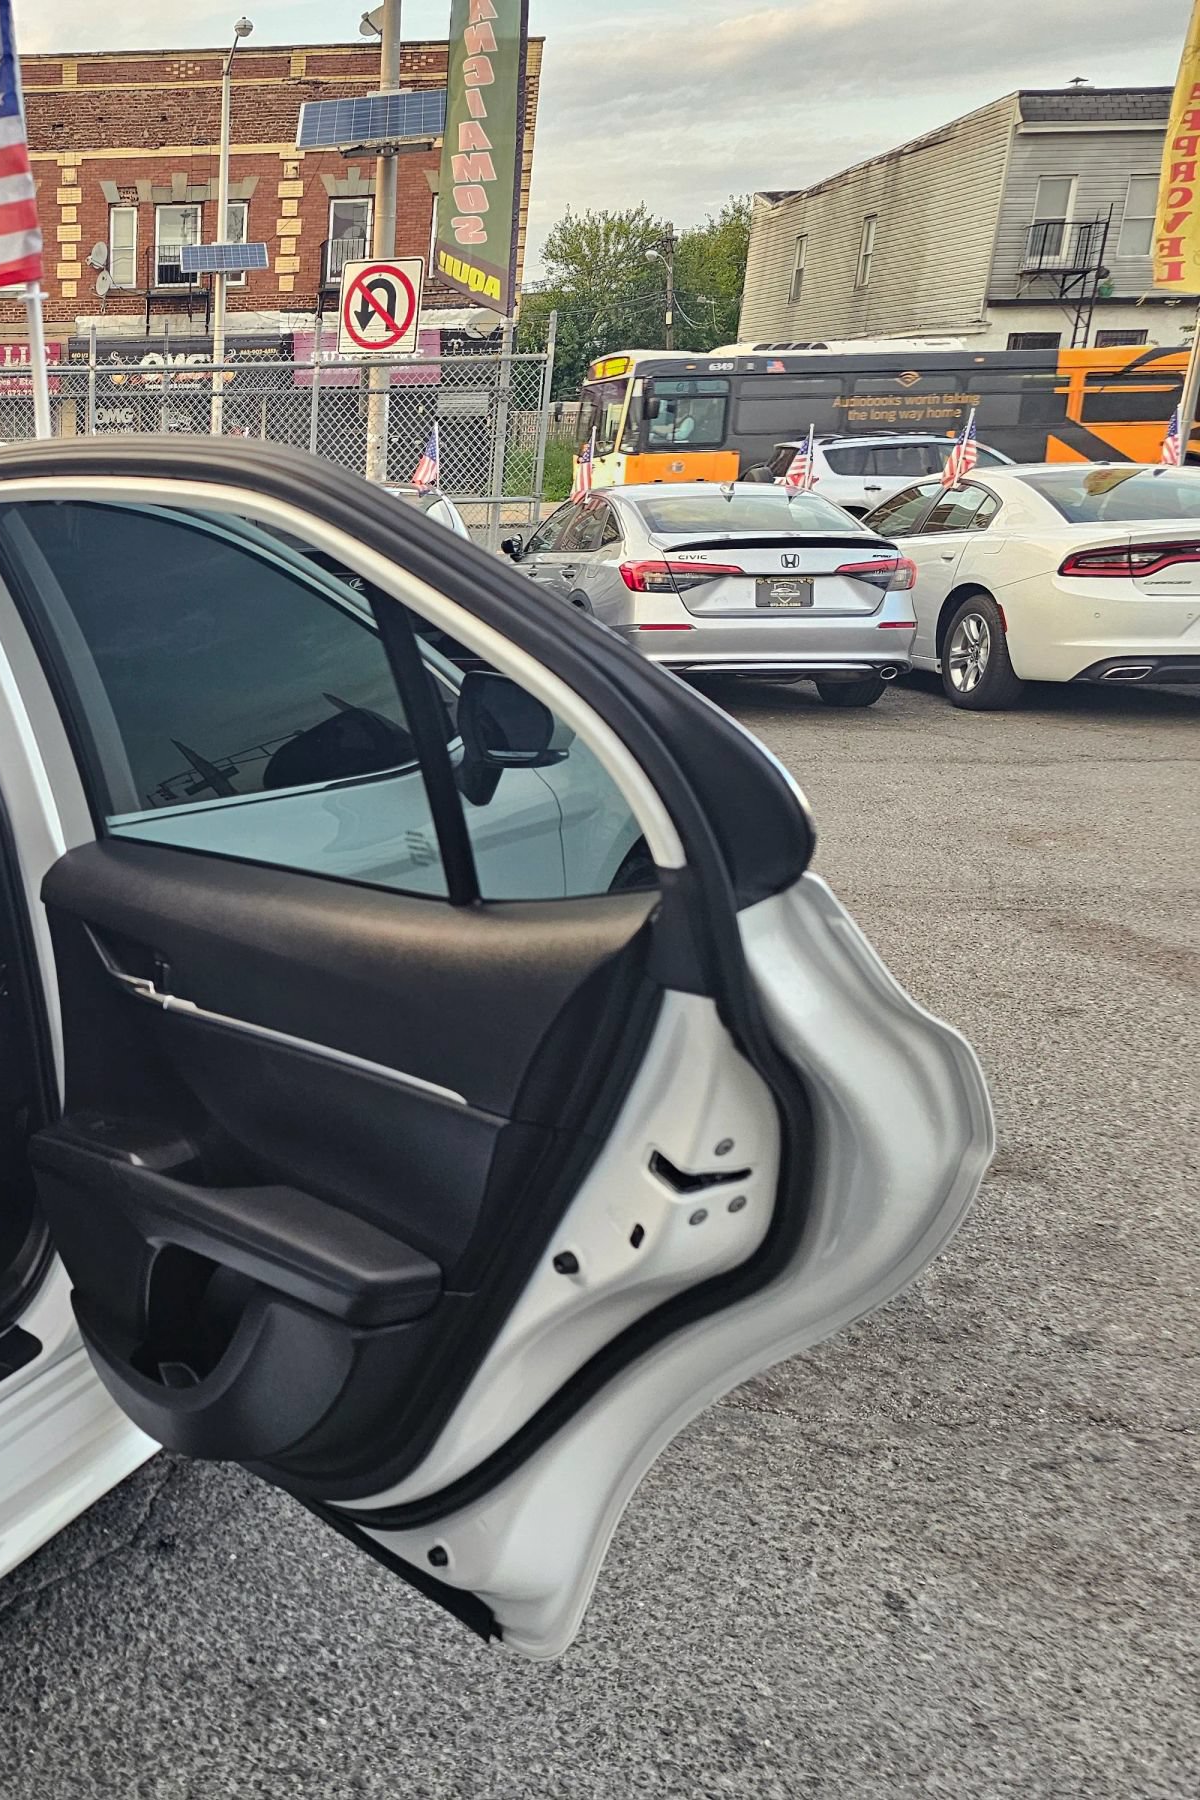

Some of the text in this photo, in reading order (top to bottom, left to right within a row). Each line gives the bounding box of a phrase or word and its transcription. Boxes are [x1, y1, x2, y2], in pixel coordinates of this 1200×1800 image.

[708, 362, 734, 371] 6349
[832, 392, 981, 408] Audiobooks worth taking
[847, 407, 962, 423] the long way home
